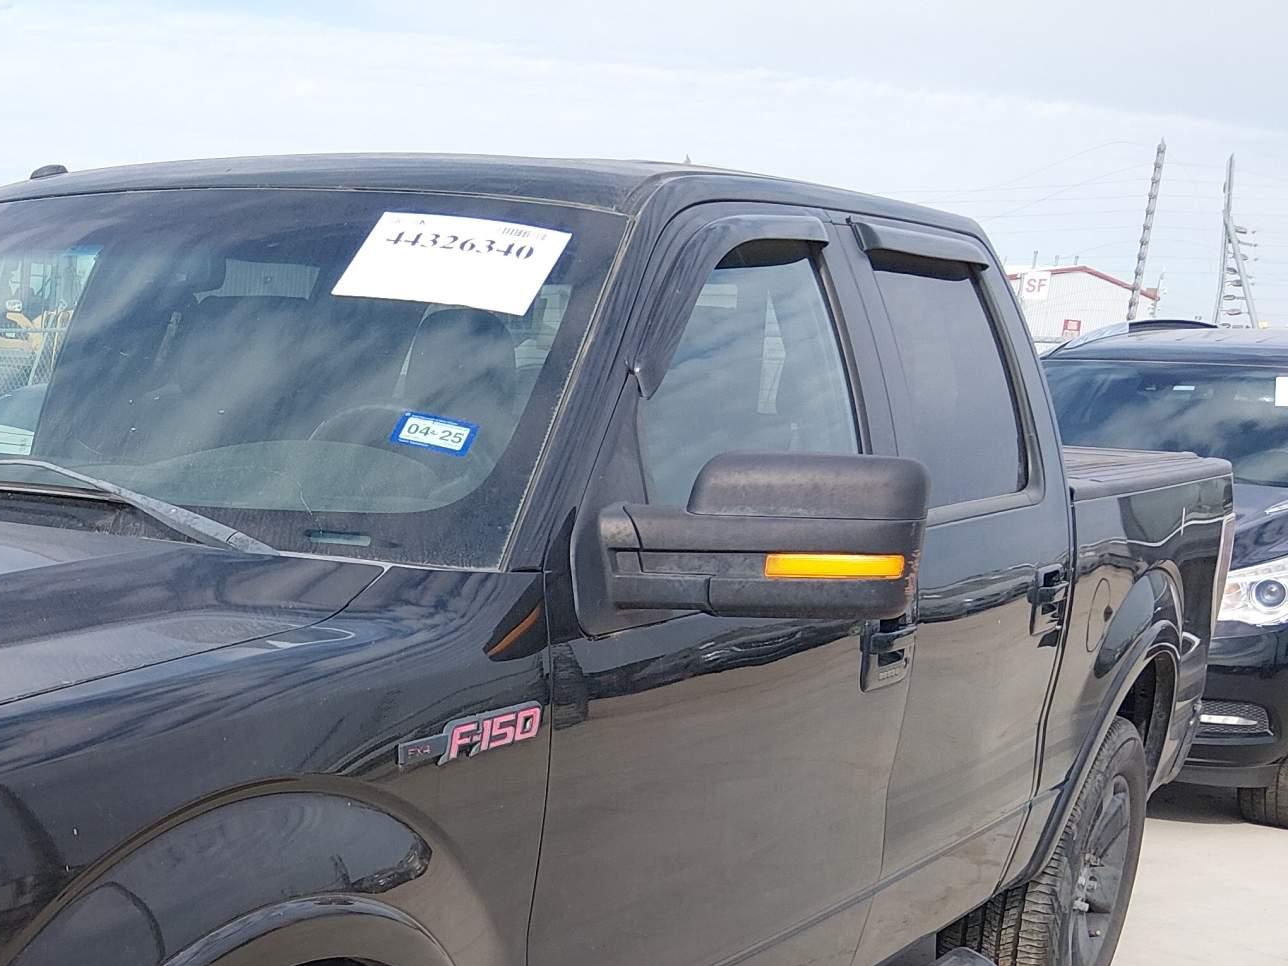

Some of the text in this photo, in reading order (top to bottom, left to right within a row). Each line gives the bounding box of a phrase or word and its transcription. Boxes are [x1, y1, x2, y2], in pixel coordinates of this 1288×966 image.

[385, 231, 534, 260] 44326340
[1025, 278, 1047, 293] SF
[448, 706, 542, 761] F-150
